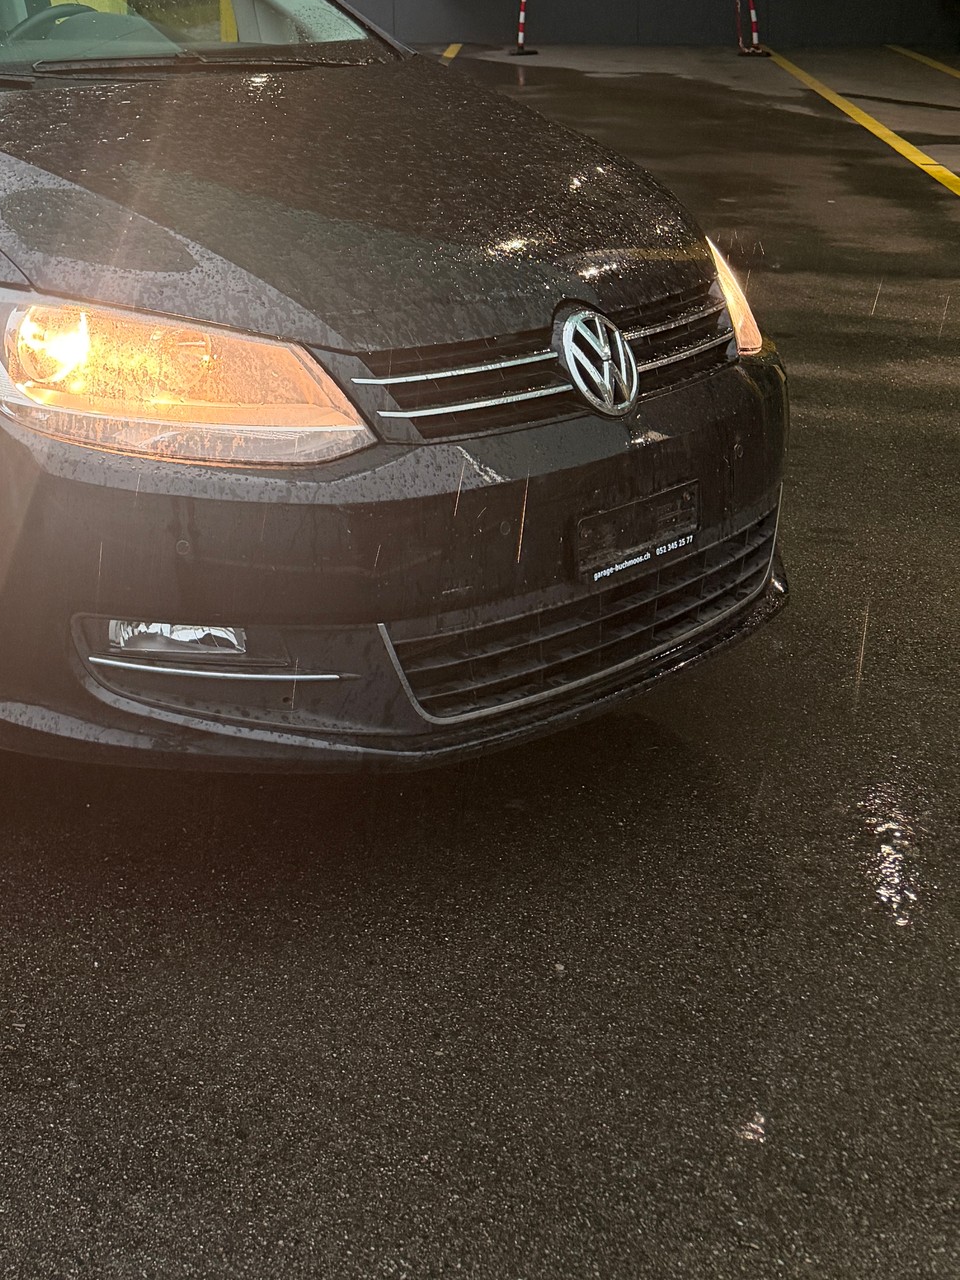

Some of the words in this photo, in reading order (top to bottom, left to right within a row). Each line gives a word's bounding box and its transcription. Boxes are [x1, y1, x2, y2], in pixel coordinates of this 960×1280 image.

[563, 310, 638, 417] VW
[593, 552, 651, 581] garage-buchmoos.ch
[656, 545, 667, 555] 052
[668, 541, 678, 551] 345
[678, 538, 686, 547] 25
[686, 535, 693, 544] 77
